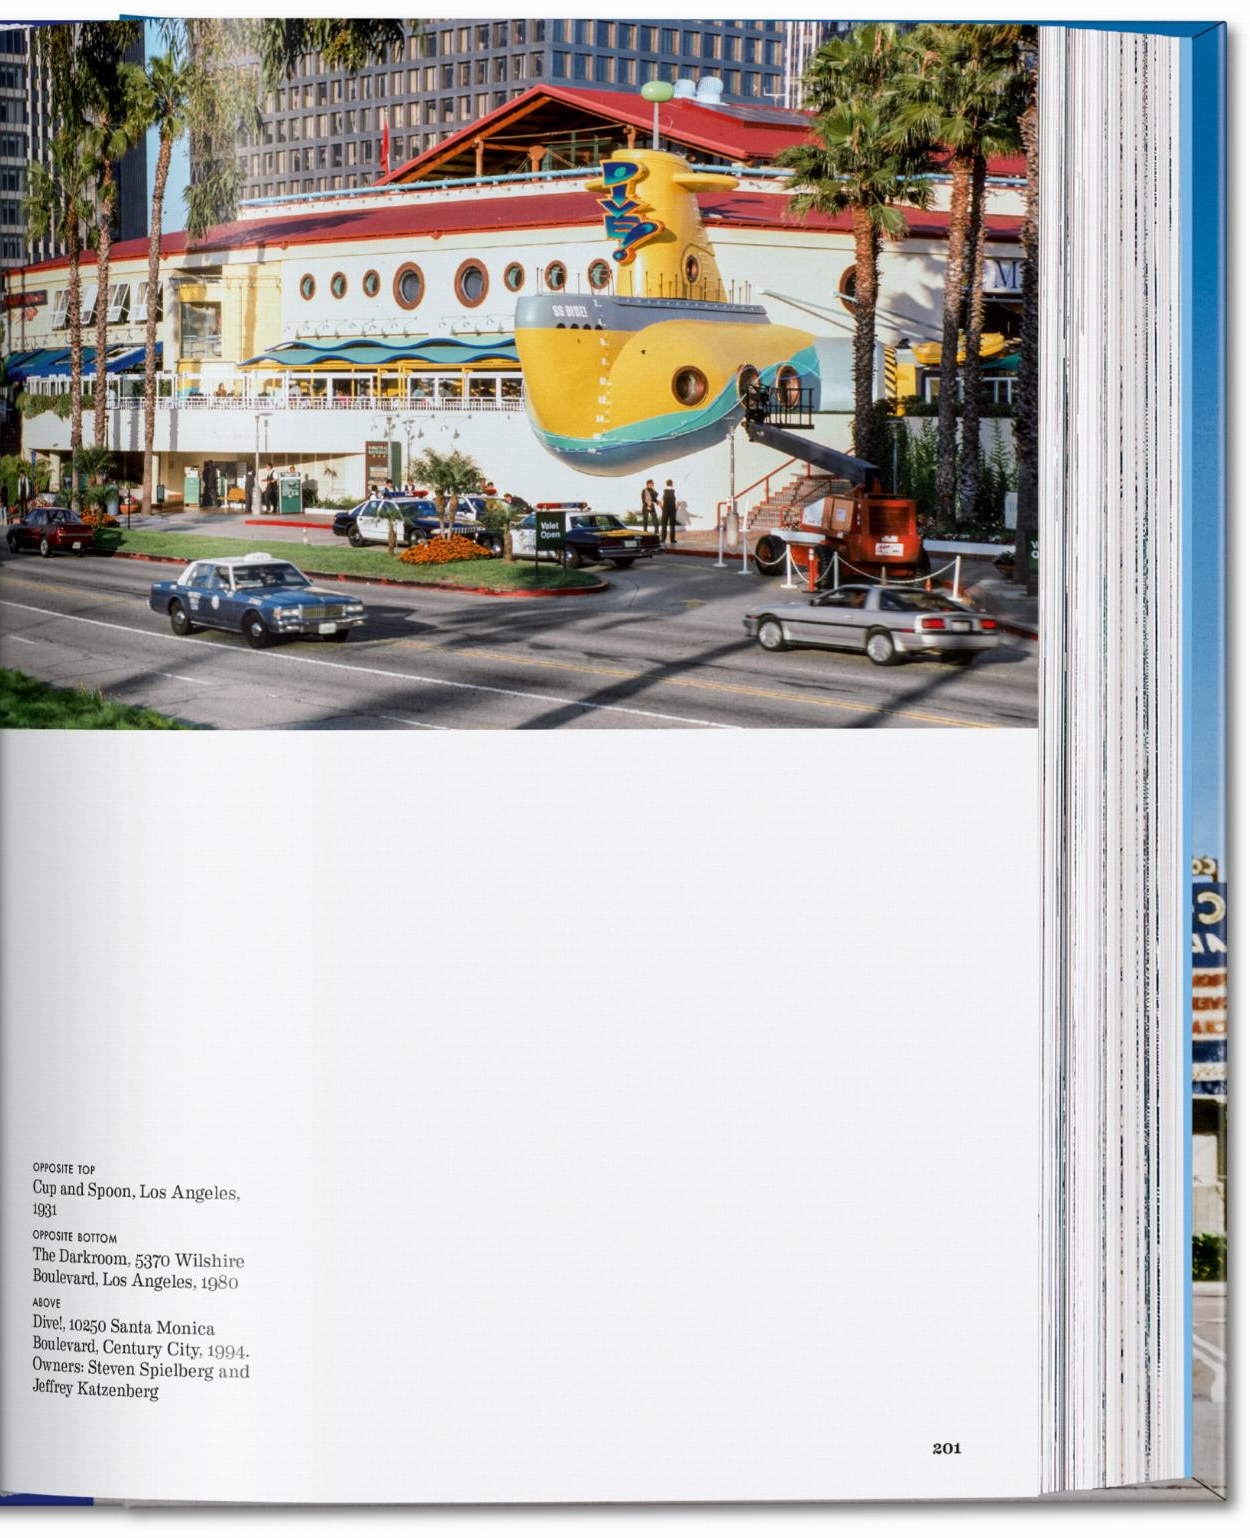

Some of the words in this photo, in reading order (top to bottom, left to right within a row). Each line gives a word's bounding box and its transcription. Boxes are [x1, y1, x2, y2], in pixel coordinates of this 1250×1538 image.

[540, 521, 559, 530] Valet
[540, 530, 561, 539] Open
[32, 1162, 74, 1175] OPPOSITE
[78, 1165, 96, 1175] TOP
[32, 1179, 57, 1197] Cup
[60, 1182, 85, 1196] and
[87, 1182, 136, 1200] Spoon,
[139, 1184, 167, 1199] Los
[170, 1185, 241, 1204] Angeles,
[32, 1203, 58, 1218] 1931
[32, 1230, 74, 1242] OPPOSITE
[77, 1232, 118, 1243] BOTTOM
[32, 1246, 56, 1262] The
[59, 1248, 132, 1267] Darkroom,
[134, 1254, 170, 1269] 5370
[175, 1253, 245, 1268] Wilshire
[32, 1268, 99, 1287] Boulevard,
[102, 1272, 128, 1287] Los
[131, 1273, 197, 1291] Angeles,
[200, 1275, 239, 1291] 1980
[32, 1297, 61, 1309] ABOVE
[32, 1314, 66, 1330] Dive!,
[69, 1318, 107, 1335] 10250
[110, 1318, 153, 1334] Santa
[156, 1320, 216, 1336] Monica
[32, 1335, 99, 1355] Boulevard,
[102, 1339, 163, 1358] Century
[167, 1341, 203, 1359] City,
[207, 1344, 250, 1360] 1994.
[32, 1356, 85, 1373] Owners:
[87, 1360, 135, 1376] Steven
[139, 1361, 214, 1382] Spielberg
[218, 1364, 250, 1379] and
[32, 1378, 74, 1398] Jeffrey
[77, 1381, 159, 1402] Katzenberg
[932, 1442, 962, 1455] 201
